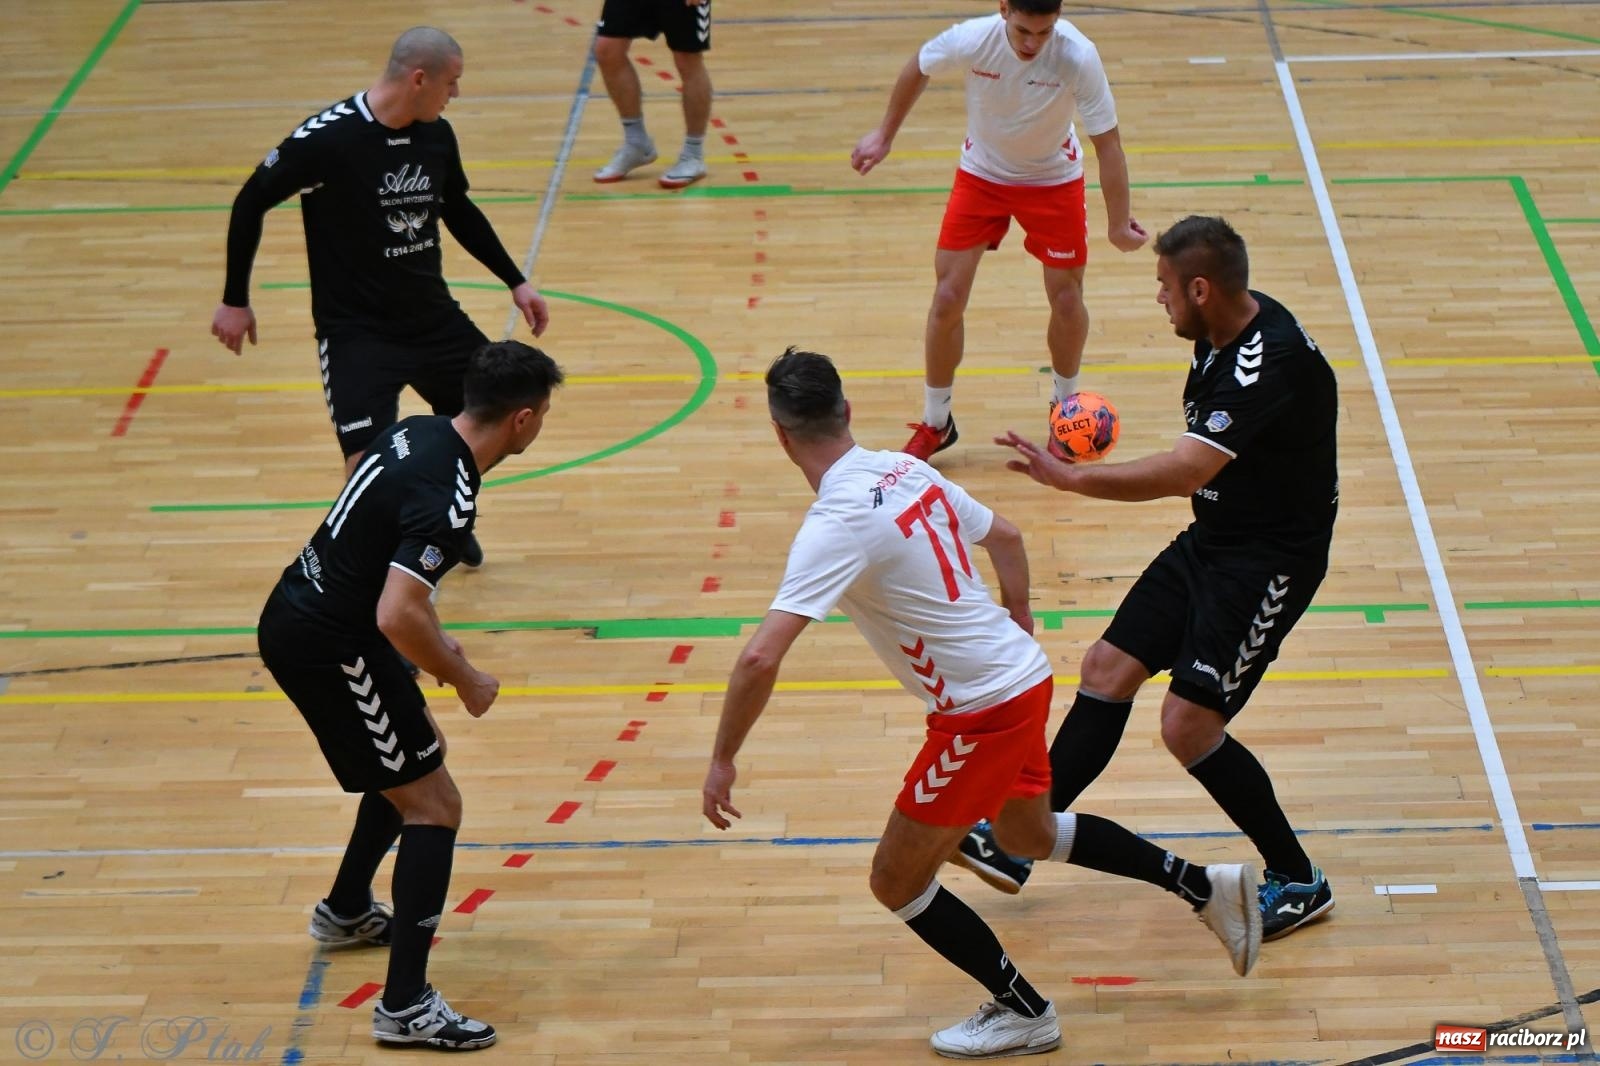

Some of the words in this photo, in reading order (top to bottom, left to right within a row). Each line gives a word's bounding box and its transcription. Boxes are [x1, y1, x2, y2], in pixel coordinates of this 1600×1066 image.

[378, 163, 431, 195] Ada
[380, 197, 402, 207] SALON
[392, 246, 408, 257] 514
[341, 416, 373, 434] hummel
[1057, 418, 1091, 436] SELECT
[326, 453, 385, 540] 11
[894, 483, 973, 602] 77
